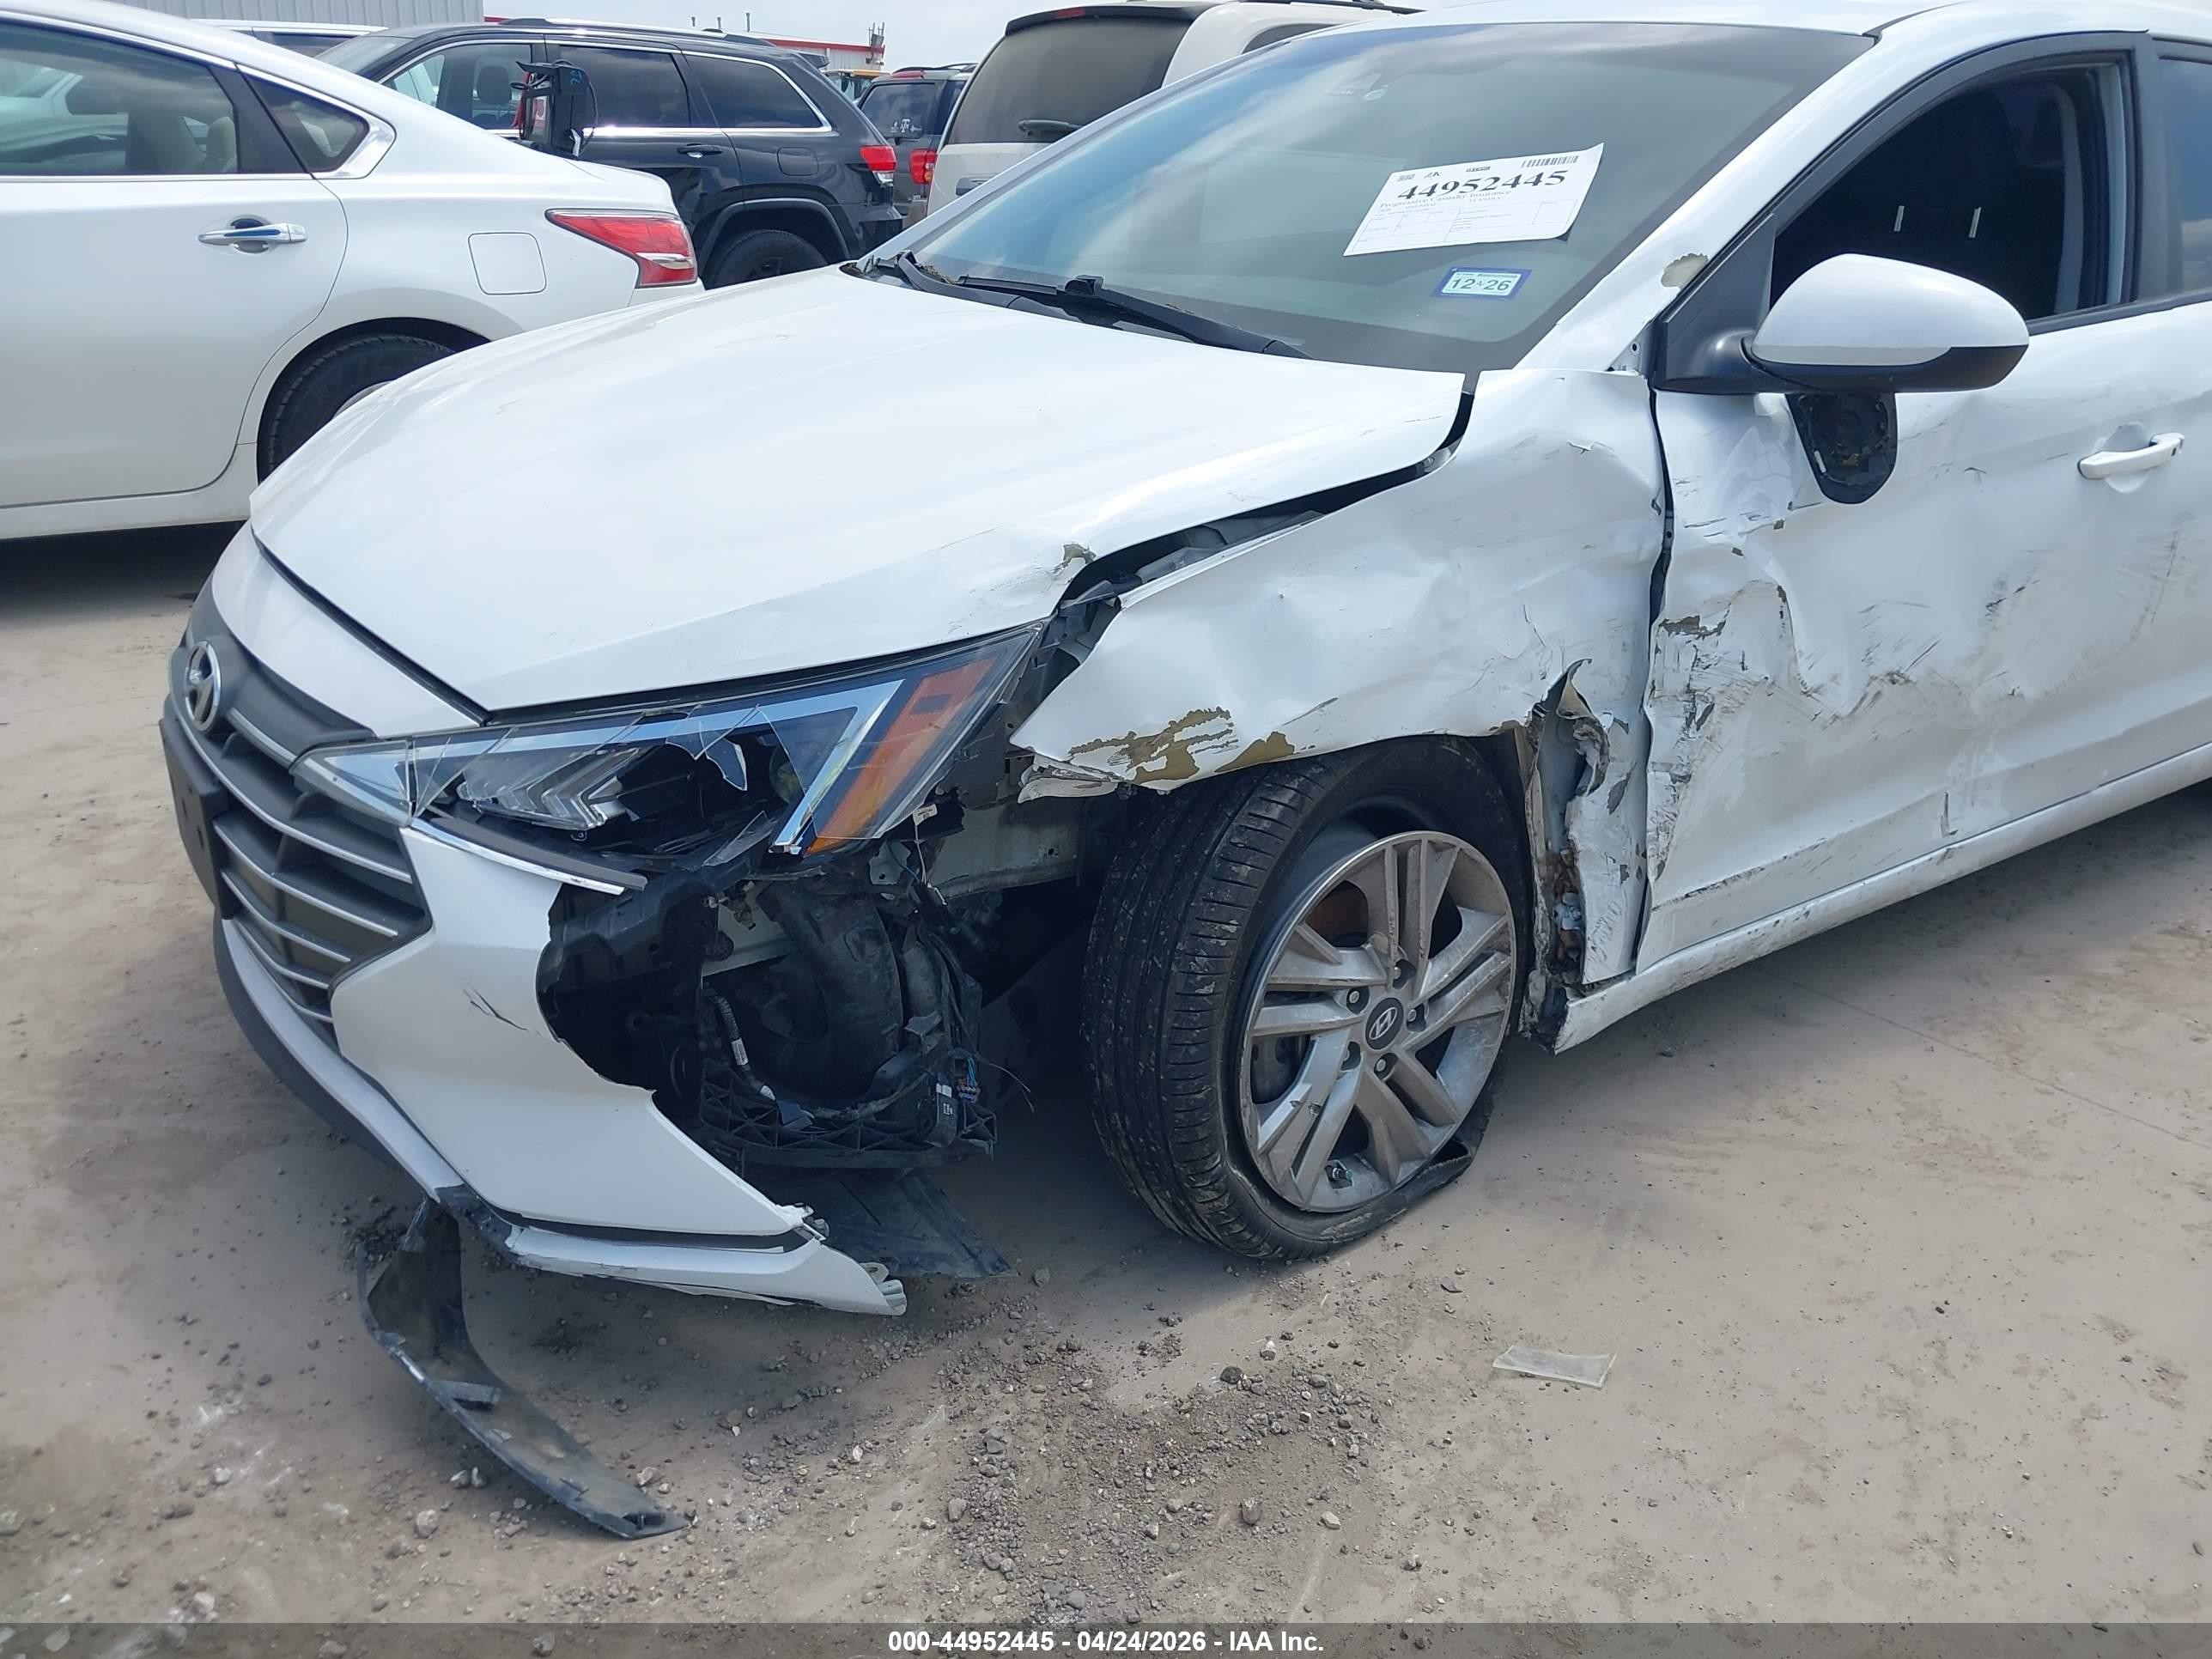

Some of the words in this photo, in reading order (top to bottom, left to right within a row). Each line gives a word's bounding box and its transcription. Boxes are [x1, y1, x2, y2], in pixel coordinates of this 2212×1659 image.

[1397, 170, 1568, 200] 44952445
[1452, 278, 1476, 289] 12
[1484, 279, 1512, 291] 26
